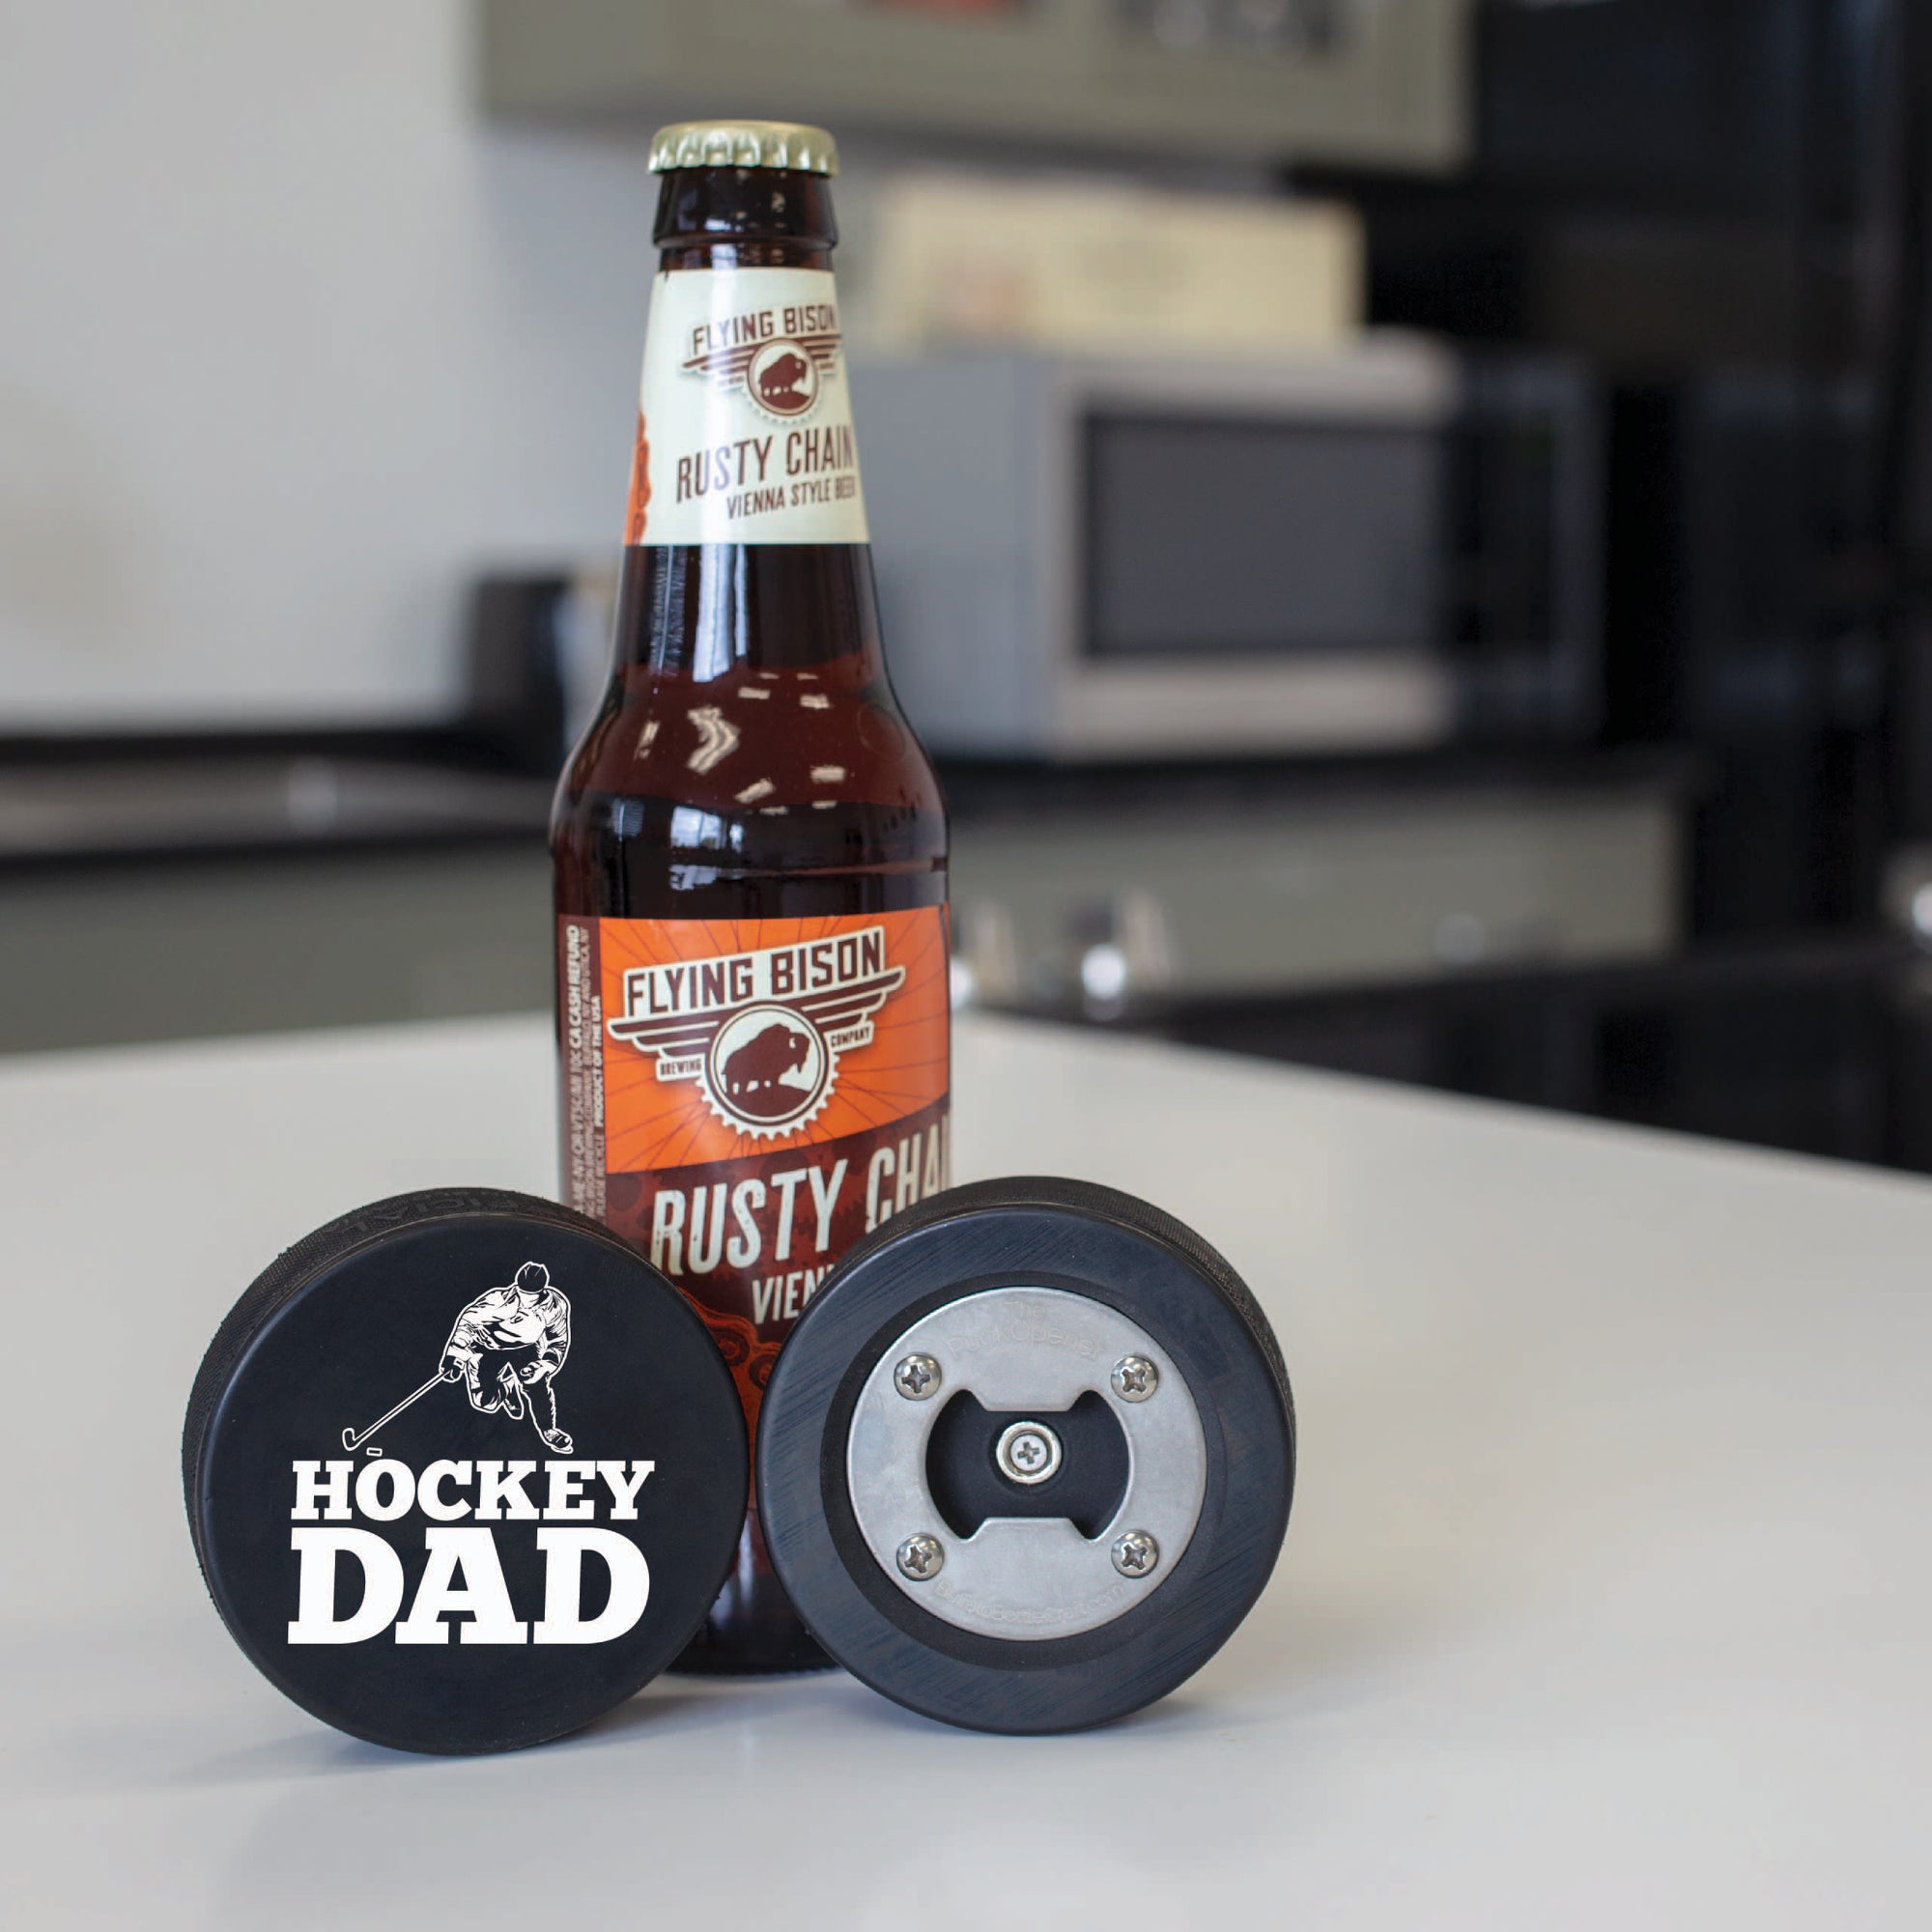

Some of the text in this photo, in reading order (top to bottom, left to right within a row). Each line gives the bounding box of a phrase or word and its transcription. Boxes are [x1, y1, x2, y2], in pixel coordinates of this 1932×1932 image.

[693, 302, 837, 355] FLYING BISON
[676, 424, 855, 504] RUSTY CHAIN
[726, 484, 786, 521] VIENNA
[791, 477, 831, 507] STYLE
[566, 924, 581, 985] REFUND
[628, 931, 881, 1016] FLYING BISON
[567, 985, 582, 1026] CASH
[590, 995, 601, 1022] USA
[830, 1025, 870, 1048] COMPANY
[659, 1059, 701, 1076] BREWING
[649, 1158, 849, 1276] RUSTY
[752, 1264, 835, 1325] VIEN
[291, 1460, 656, 1521] HOCKEY
[287, 1527, 650, 1644] DAD
